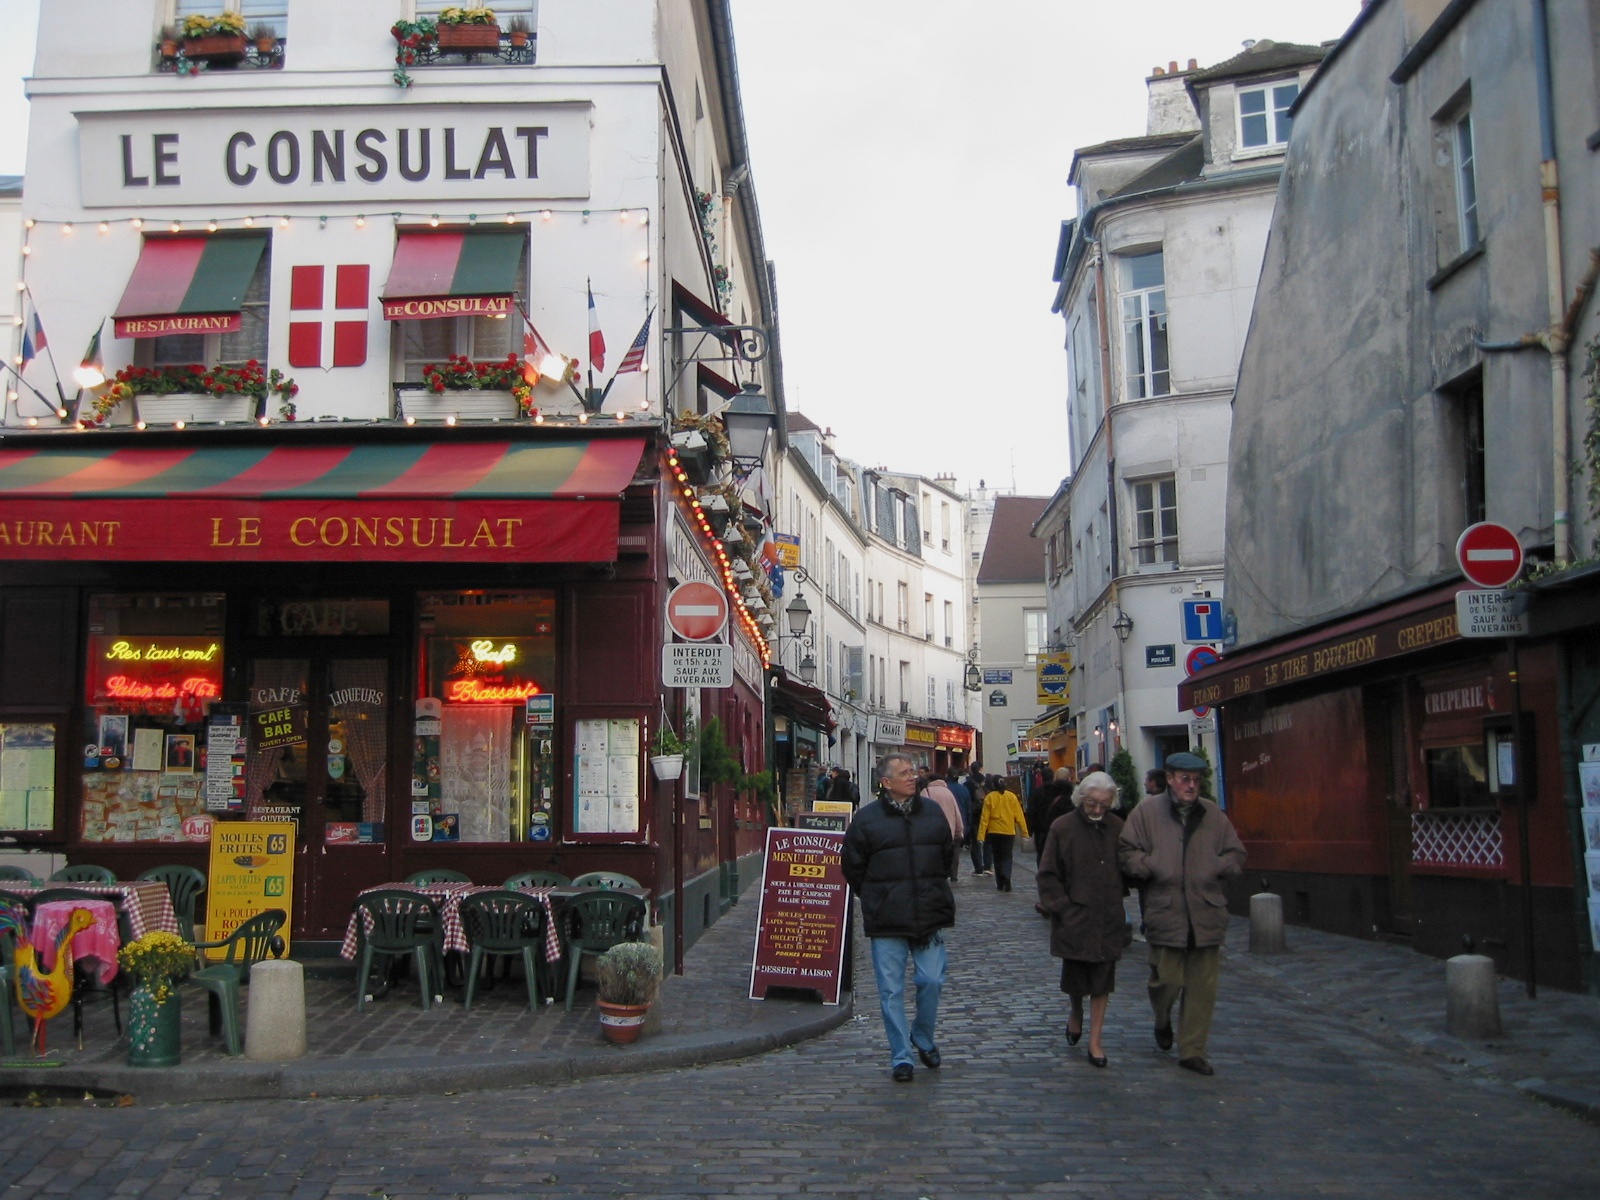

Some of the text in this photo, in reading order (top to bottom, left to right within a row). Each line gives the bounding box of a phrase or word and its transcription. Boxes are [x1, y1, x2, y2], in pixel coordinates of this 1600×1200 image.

[120, 126, 549, 187] LE CONSULAT
[387, 298, 510, 316] LE CONSULAT
[125, 316, 231, 333] RESTAURANT
[0, 521, 120, 546] AURANT
[210, 517, 523, 547] LE CONSULAT
[1483, 605, 1497, 613] 15h
[1473, 615, 1519, 624] SAUF AUX
[1398, 614, 1458, 649] CREPERI
[1471, 623, 1522, 633] RIVERAINS
[106, 641, 219, 662] Restaurant
[673, 648, 722, 658] INTERDIT
[686, 658, 700, 666] 15h
[711, 658, 722, 666] 2h
[1264, 634, 1377, 685] LE TIRE BOUCHON
[106, 675, 154, 699] Salon
[155, 683, 177, 698] de
[673, 676, 722, 684] RIVERAINS
[328, 687, 384, 707] LIQUEURS
[449, 680, 539, 701] Brasserie
[1193, 675, 1250, 705] PIANO BAR
[1425, 685, 1484, 714] CREPERIE
[258, 706, 292, 725] CAFÉ
[264, 723, 293, 738] BAR
[252, 806, 301, 814] RESTAURANT
[220, 833, 263, 843] MOULES
[270, 836, 284, 851] 65
[775, 838, 790, 851] LE
[218, 844, 262, 854] FRITES
[772, 852, 800, 863] MENU
[804, 854, 818, 864] DU
[268, 878, 282, 893] 65
[760, 965, 833, 977] DESSERT MAISON
